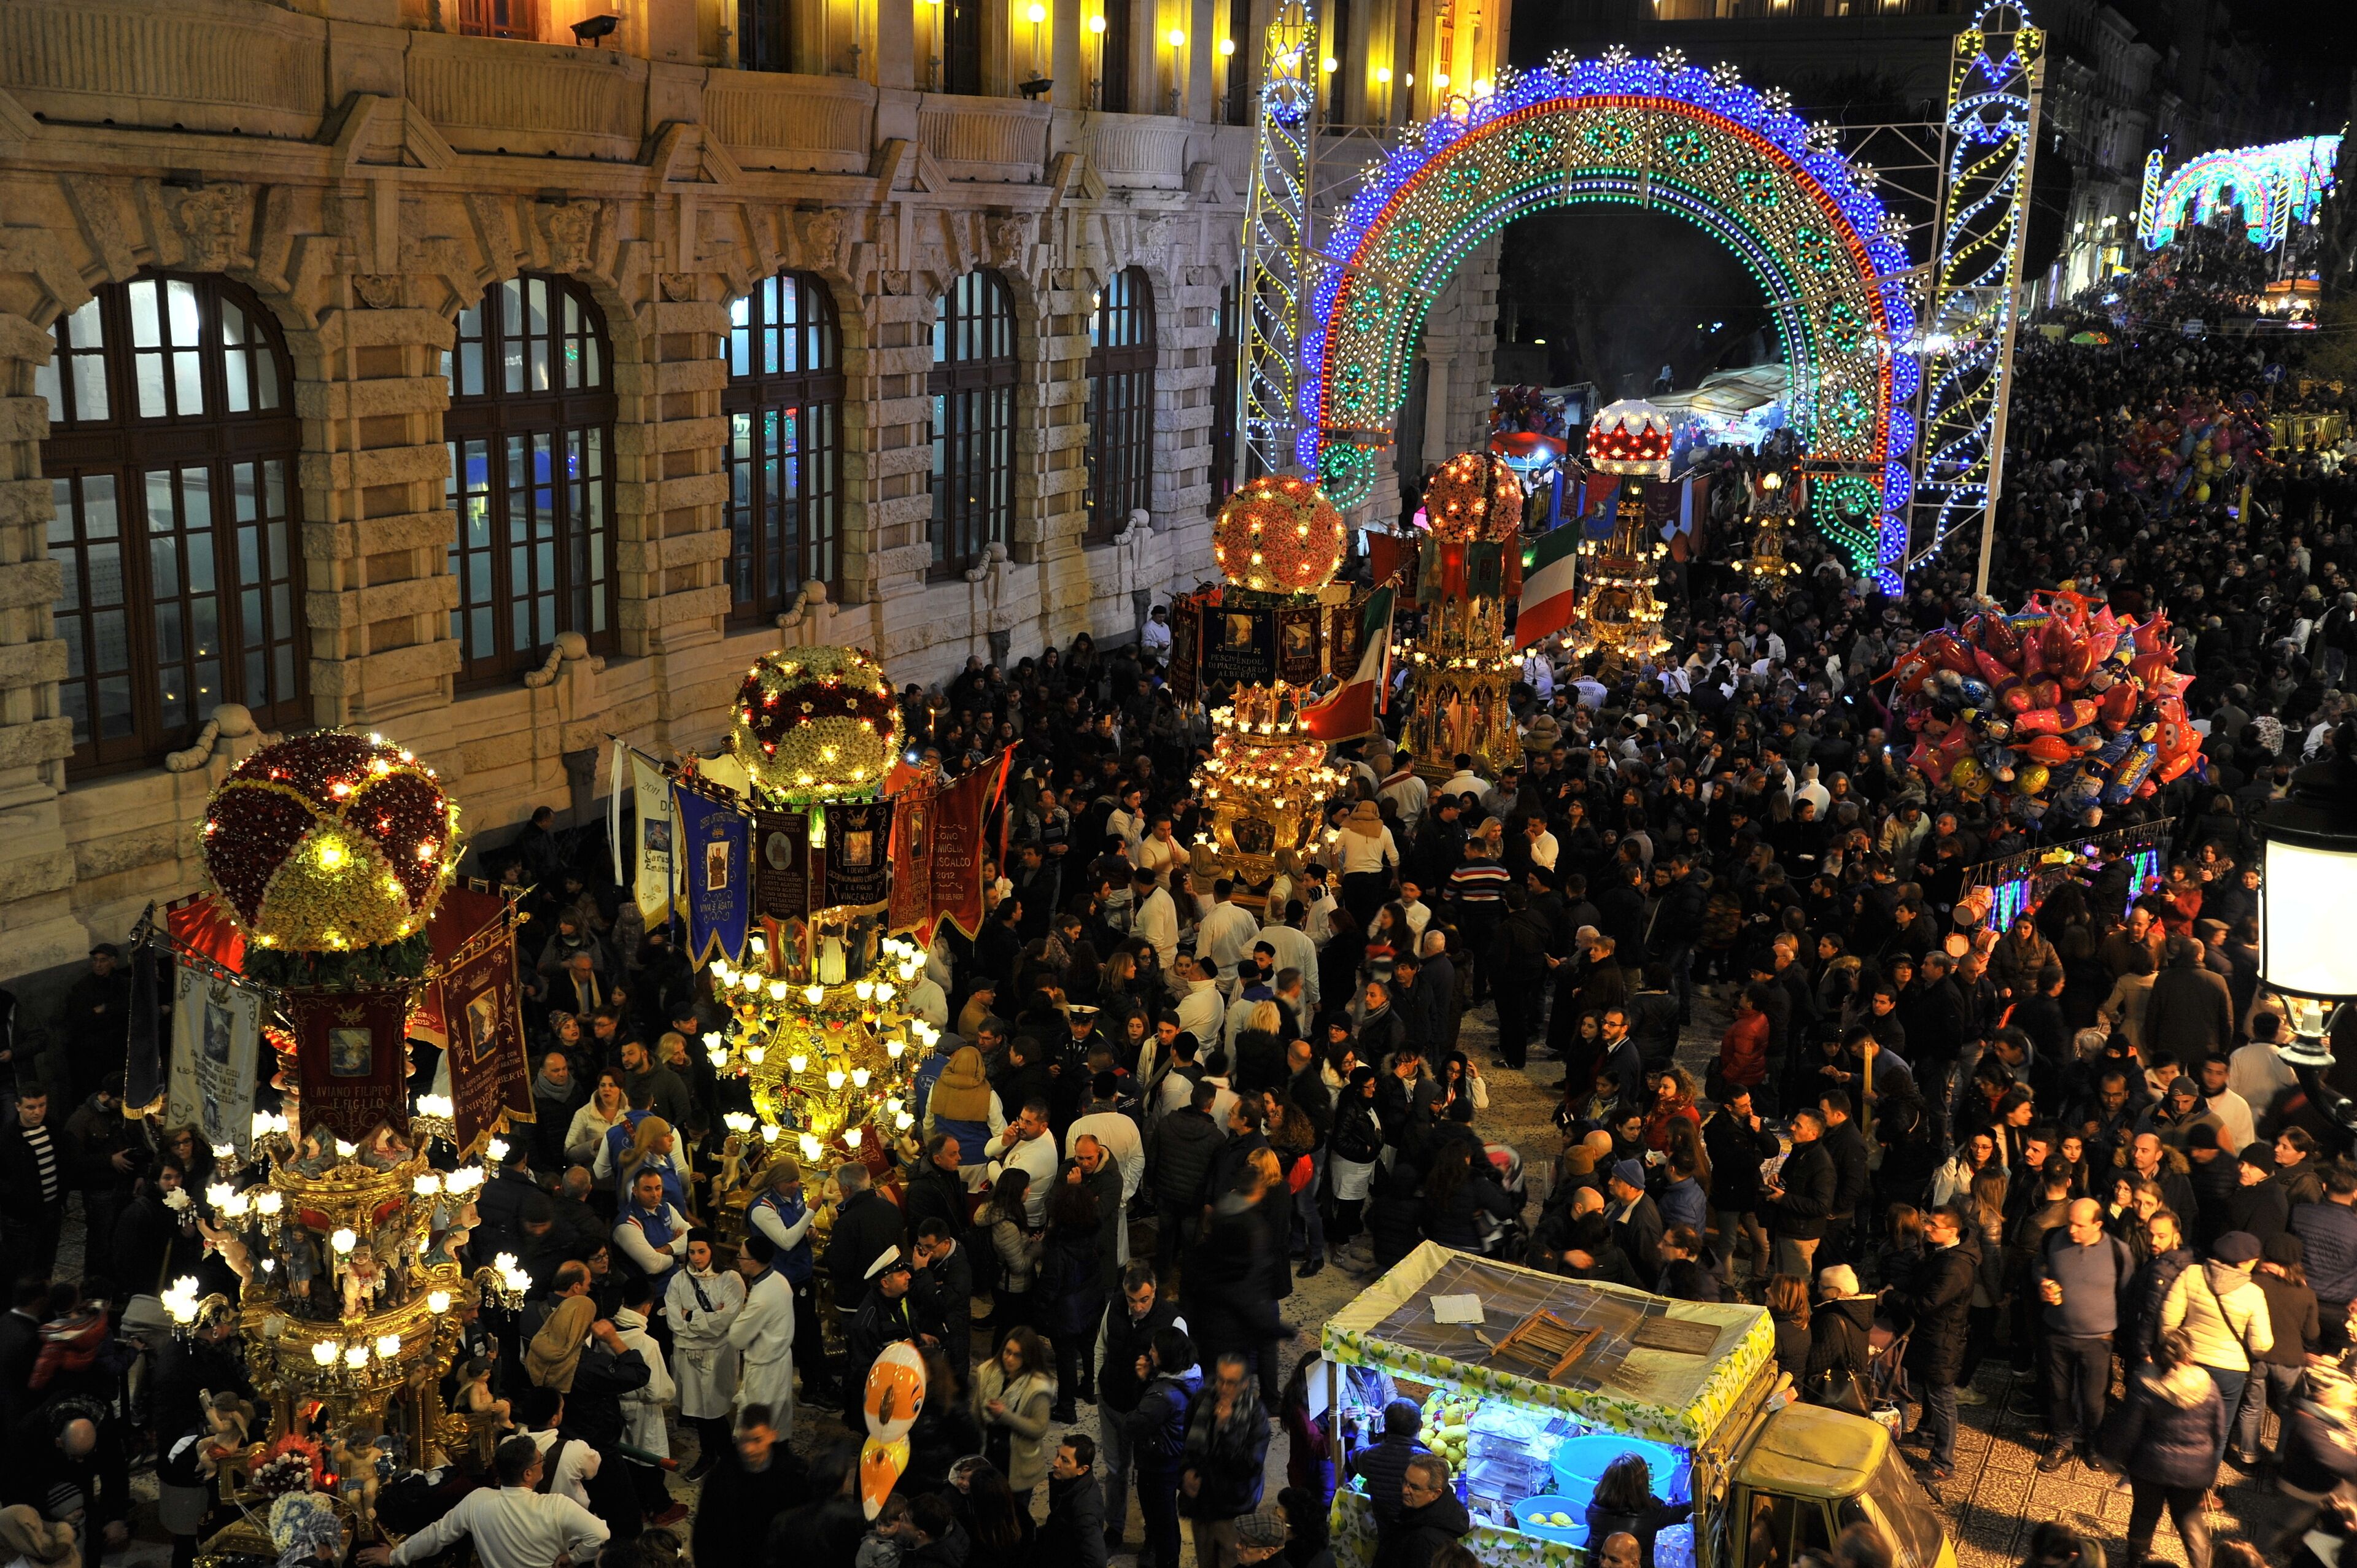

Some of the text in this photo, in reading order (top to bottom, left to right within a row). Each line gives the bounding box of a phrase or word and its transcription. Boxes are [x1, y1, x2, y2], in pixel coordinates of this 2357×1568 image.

[1211, 654, 1264, 665] PESCIVENDOLI
[641, 782, 660, 795] 2011
[937, 843, 964, 853] MIGLIA
[645, 850, 668, 863] Carus
[644, 860, 679, 874] Emanule
[840, 892, 873, 901] VINCENZO
[700, 903, 711, 913] VIVA
[718, 900, 733, 910] AGATA
[219, 1075, 237, 1088] VASTA
[355, 1085, 392, 1097] FILIPPO
